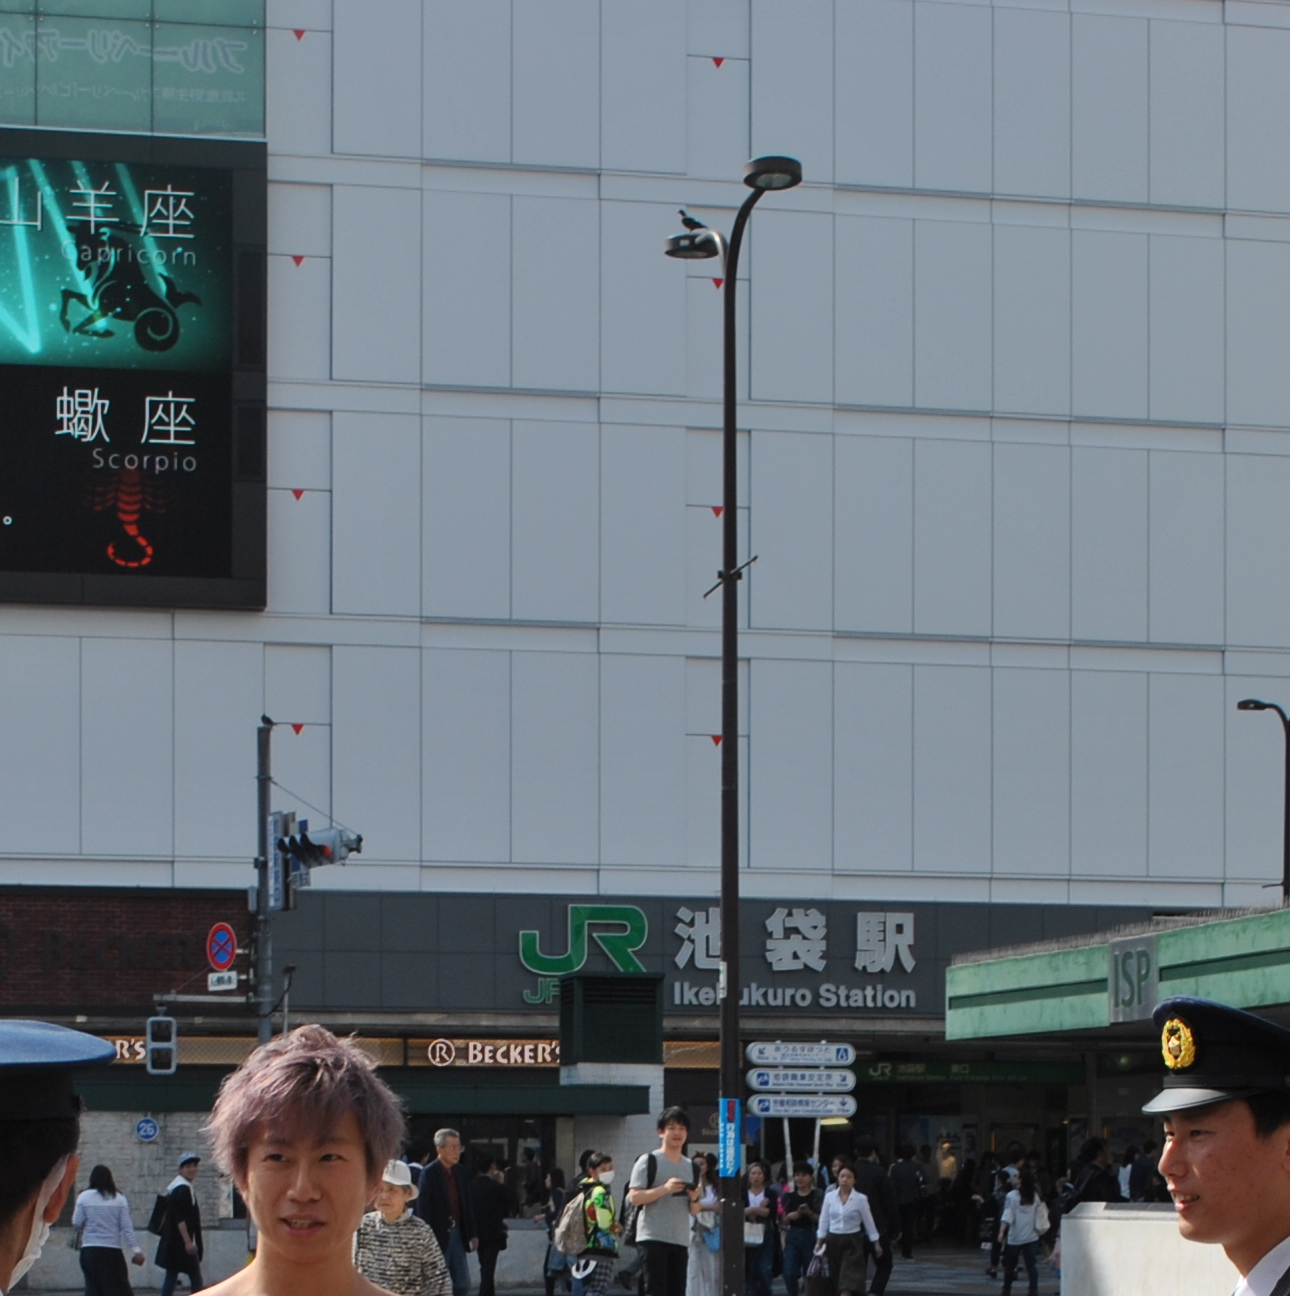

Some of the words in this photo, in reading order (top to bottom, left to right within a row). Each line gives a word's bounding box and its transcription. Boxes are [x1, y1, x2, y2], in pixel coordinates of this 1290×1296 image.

[60, 239, 196, 265] Capricorn
[55, 386, 195, 445] 蠍座
[92, 448, 196, 474] Scorpio
[518, 903, 649, 974] JR
[673, 906, 916, 974] 池袋駅
[818, 982, 916, 1009] Station
[1113, 949, 1151, 1009] ISP
[468, 1041, 560, 1065] BECKER'
